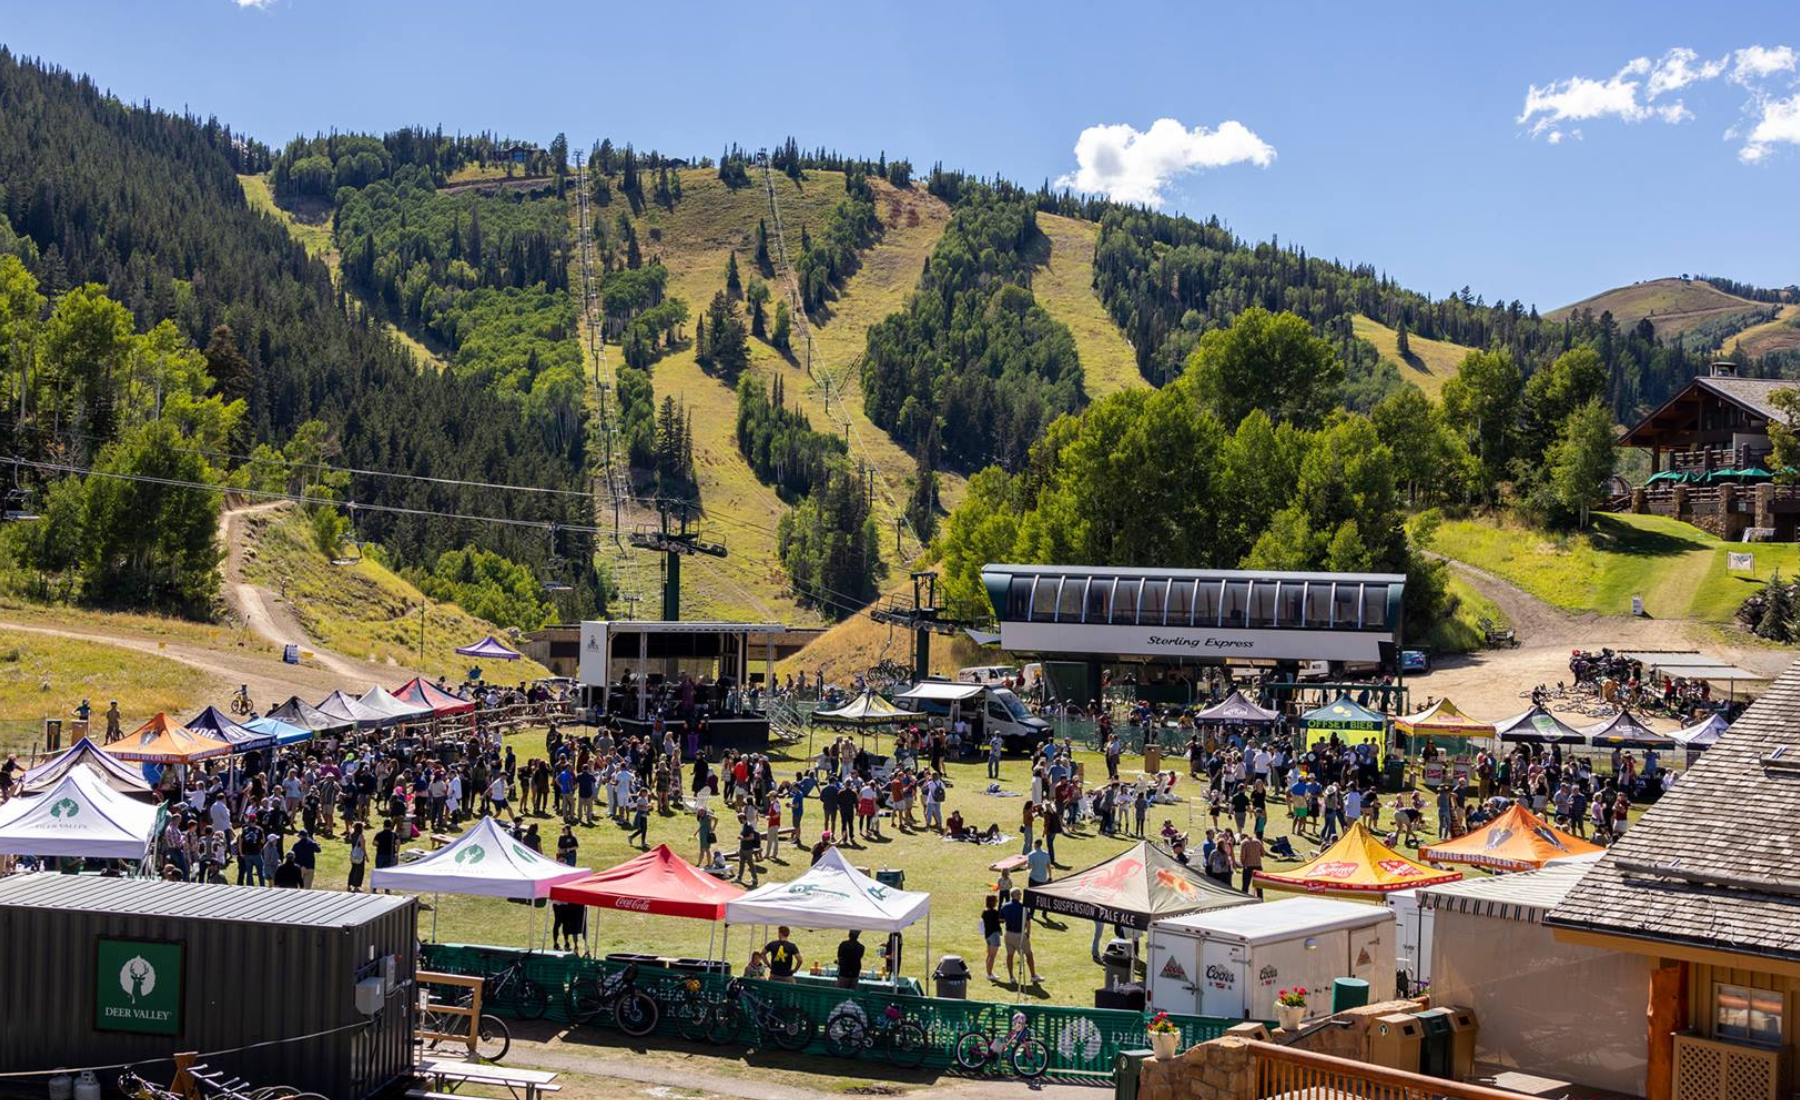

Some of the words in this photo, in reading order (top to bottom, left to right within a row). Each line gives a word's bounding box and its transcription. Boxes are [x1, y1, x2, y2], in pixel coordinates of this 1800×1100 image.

[1147, 635, 1200, 648] Sterling
[1204, 637, 1254, 649] Express
[1307, 720, 1347, 730] OFFSET
[1349, 720, 1374, 730] BIER
[1463, 853, 1518, 868] BREWERY
[1035, 895, 1052, 908] FULL
[1052, 899, 1096, 918] SUSPENSION
[1098, 907, 1119, 923] PALE
[1120, 912, 1136, 926] ALE
[1206, 964, 1235, 983] Coors
[105, 1007, 131, 1017] DEER
[132, 1009, 168, 1020] VALLEY
[1111, 1030, 1152, 1047] DEER
